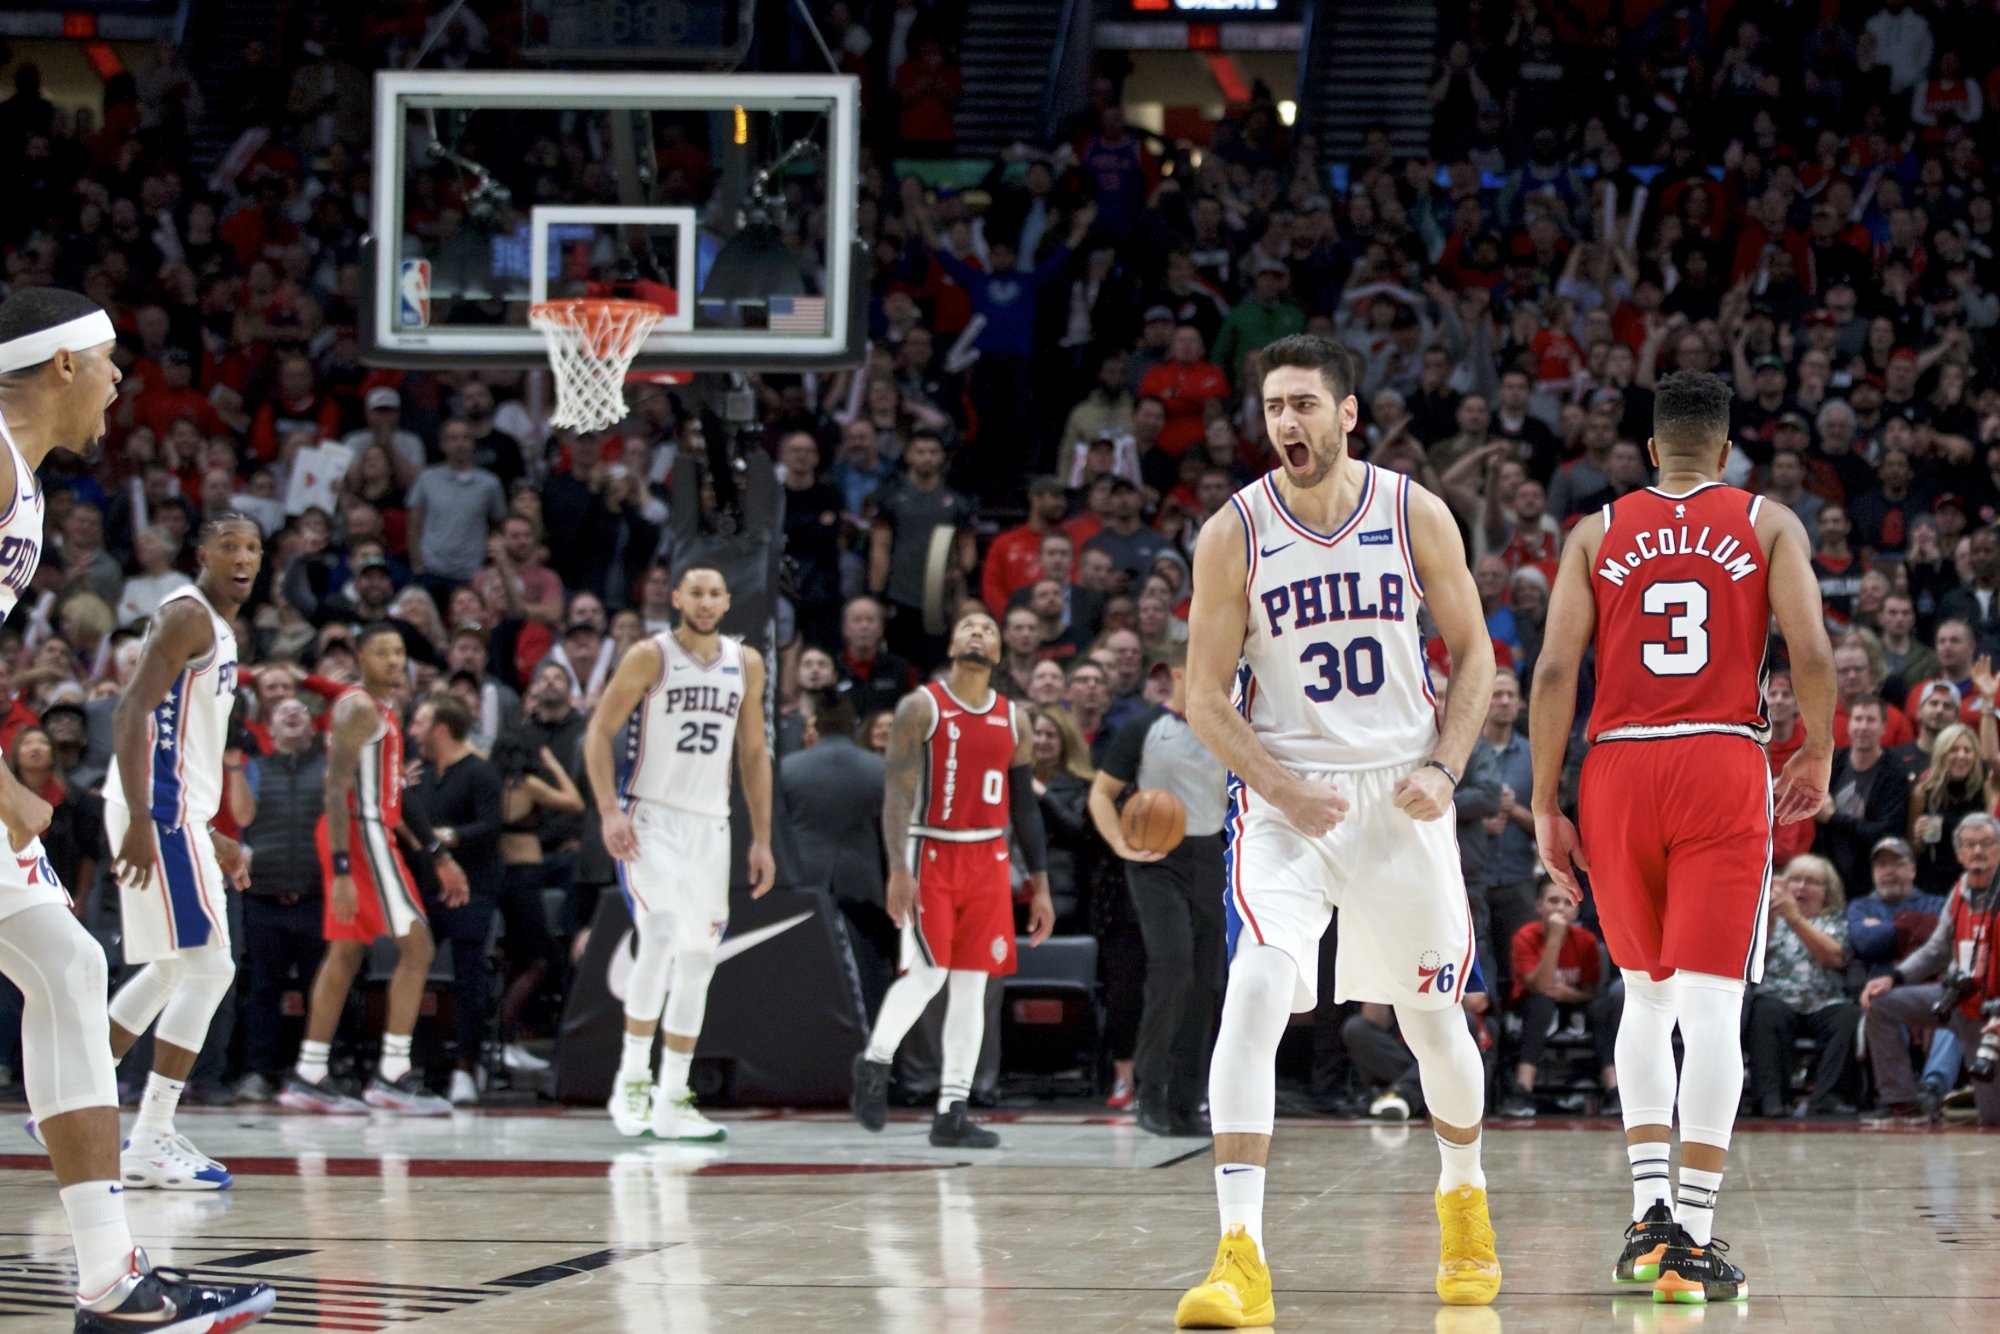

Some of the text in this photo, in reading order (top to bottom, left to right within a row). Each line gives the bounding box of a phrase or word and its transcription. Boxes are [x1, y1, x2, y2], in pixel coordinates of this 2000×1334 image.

[1598, 525, 1758, 587] McCOLLUM
[1261, 572, 1404, 638] PHILA
[1641, 580, 1710, 677] 3
[1300, 636, 1385, 703] 30
[665, 686, 739, 718] PHILA
[676, 721, 721, 755] 25
[982, 768, 1004, 806] 0
[16, 855, 58, 887] 76
[1417, 962, 1454, 993] 76
